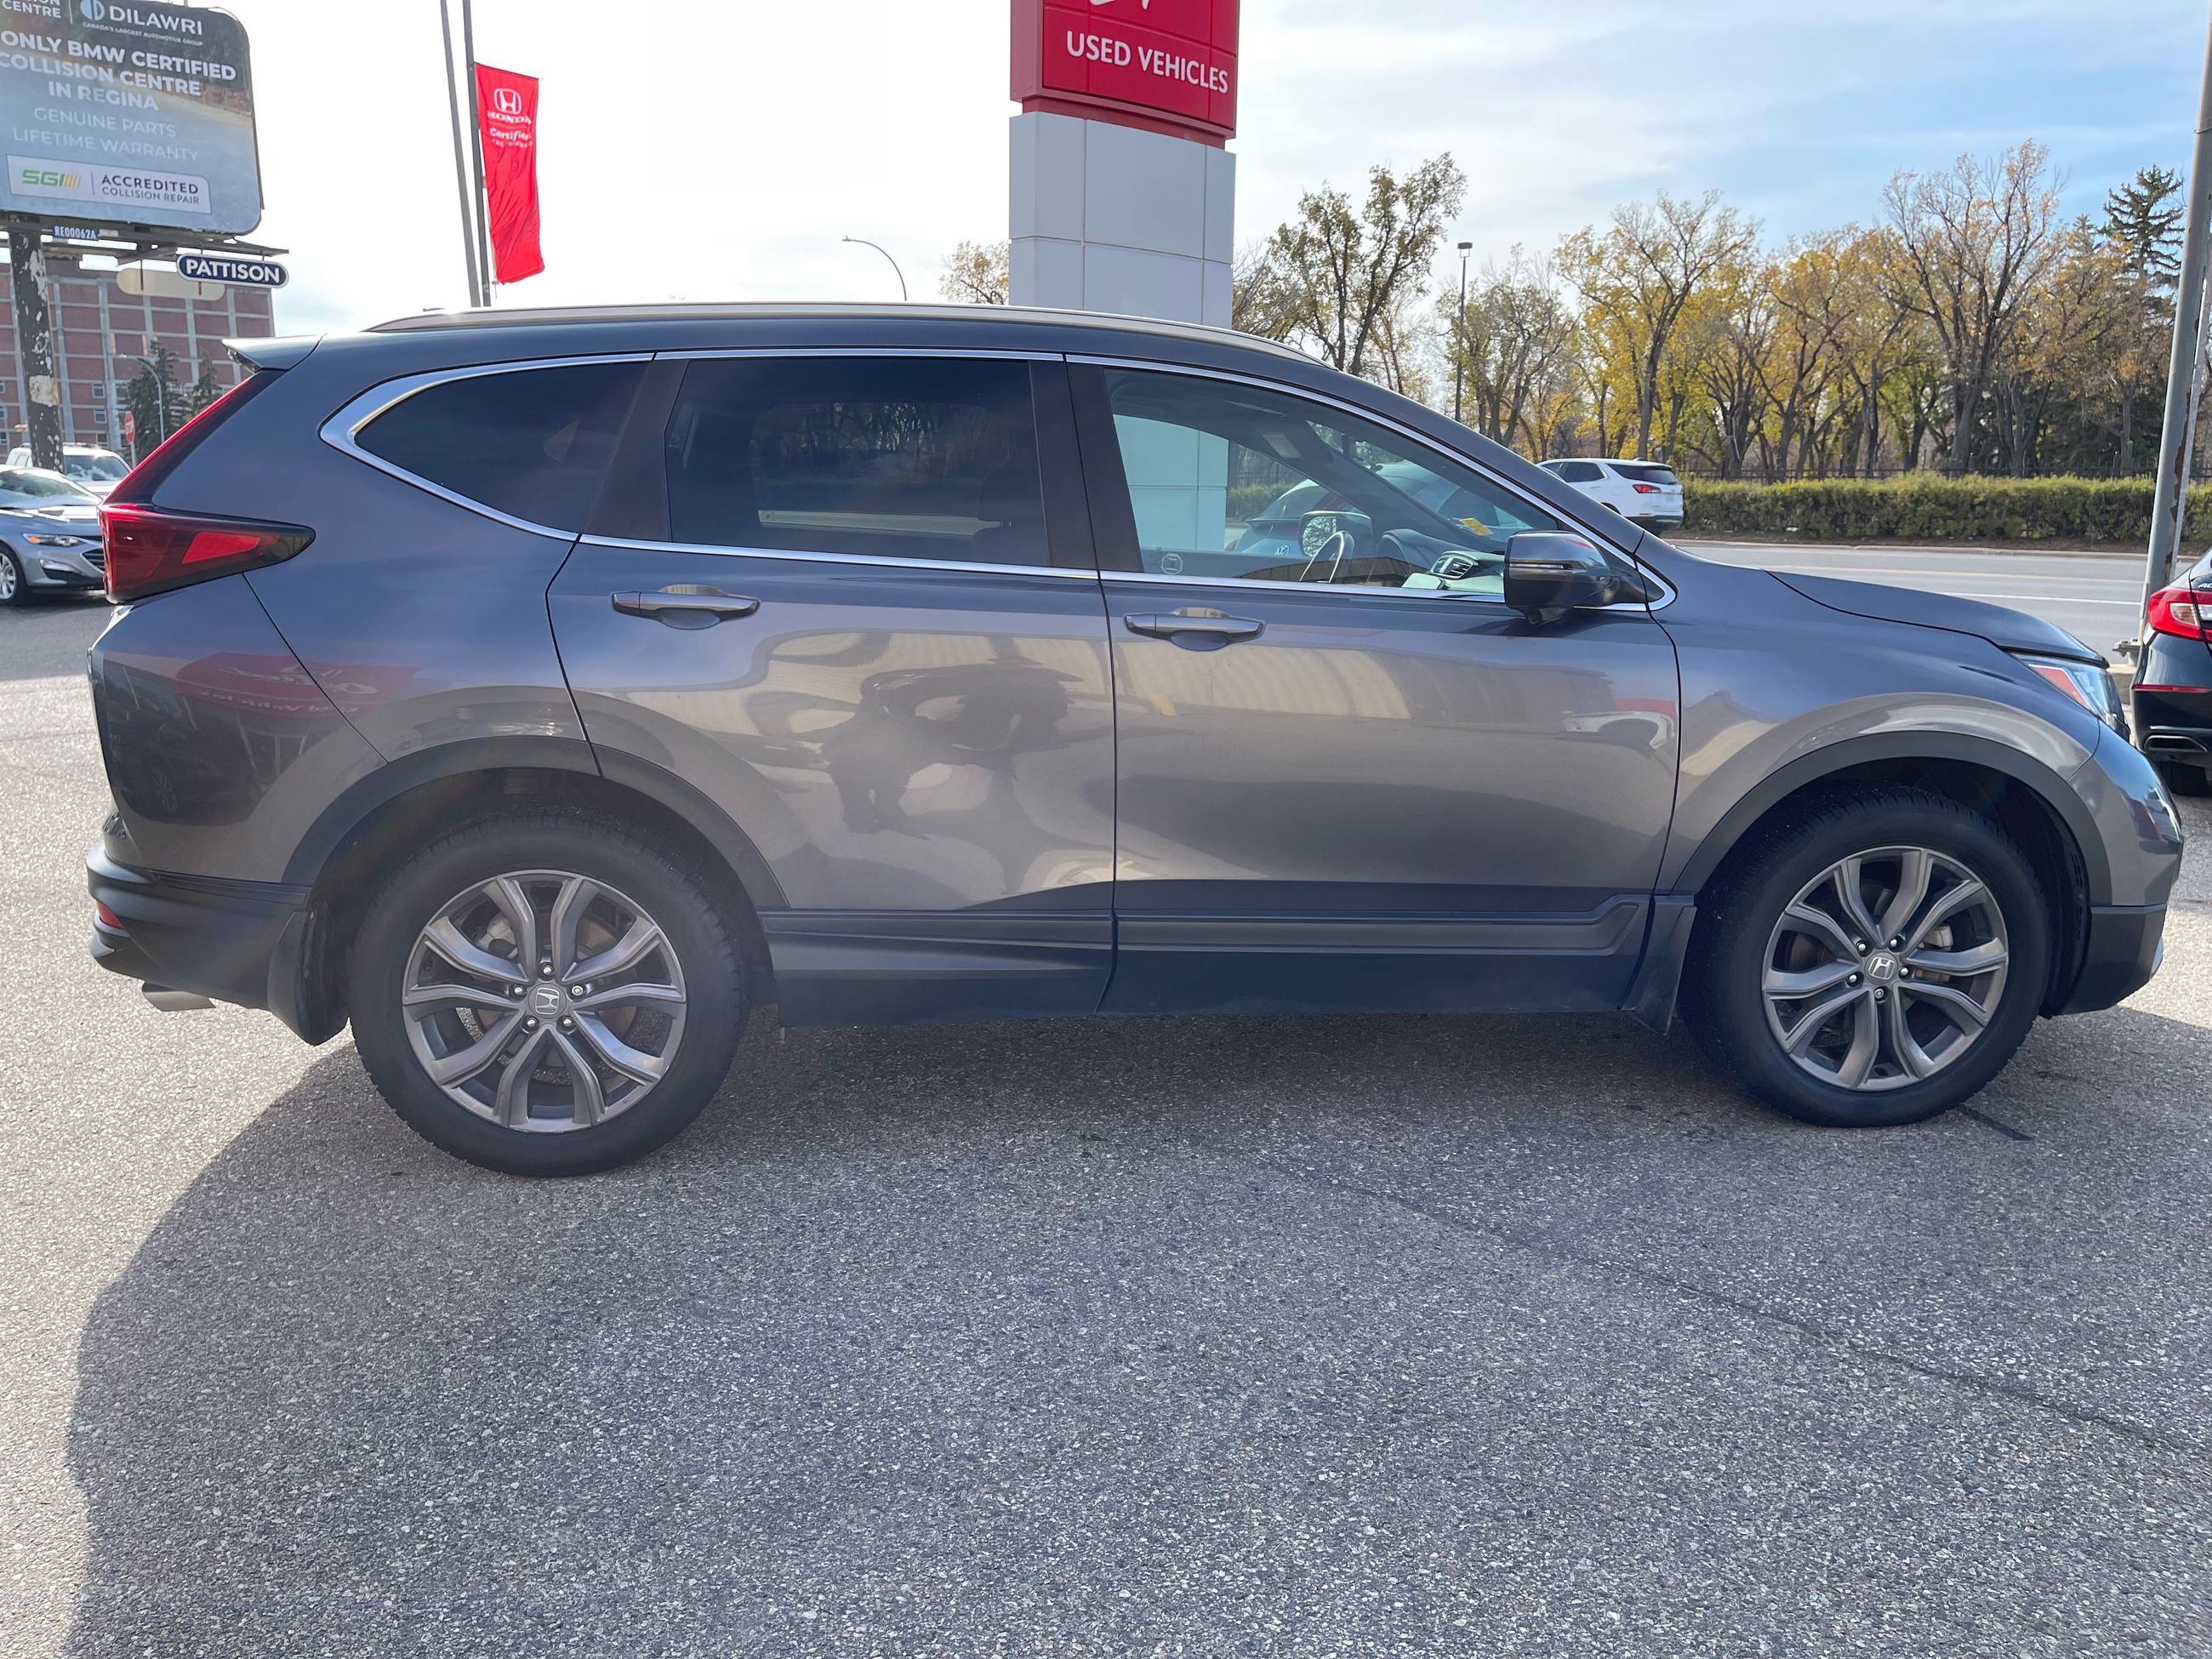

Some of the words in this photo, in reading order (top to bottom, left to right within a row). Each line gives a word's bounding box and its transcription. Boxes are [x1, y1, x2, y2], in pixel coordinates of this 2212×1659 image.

[2, 0, 61, 18] CENTRE
[109, 5, 202, 35] DILAWRI
[1, 30, 61, 53] ONLY
[67, 40, 125, 63] BMW
[131, 51, 237, 81] CERTIFIED
[1067, 31, 1132, 66] USED
[1137, 46, 1229, 94] VEHICLES
[0, 52, 114, 83] COLLISION
[119, 71, 202, 96] CENTRE
[48, 81, 71, 99] IN
[77, 86, 159, 111] REGINA
[34, 107, 117, 130] GENUINE
[123, 118, 176, 137] PARTS
[487, 111, 533, 125] HONDA
[14, 128, 96, 150] LIFETIME
[100, 138, 198, 161] WARRANTY
[101, 174, 198, 194] ACCREDITED
[102, 186, 161, 201] COLLISION
[164, 194, 200, 205] REPAIR
[54, 225, 97, 239] RE00062A
[186, 258, 280, 283] PATTISON
